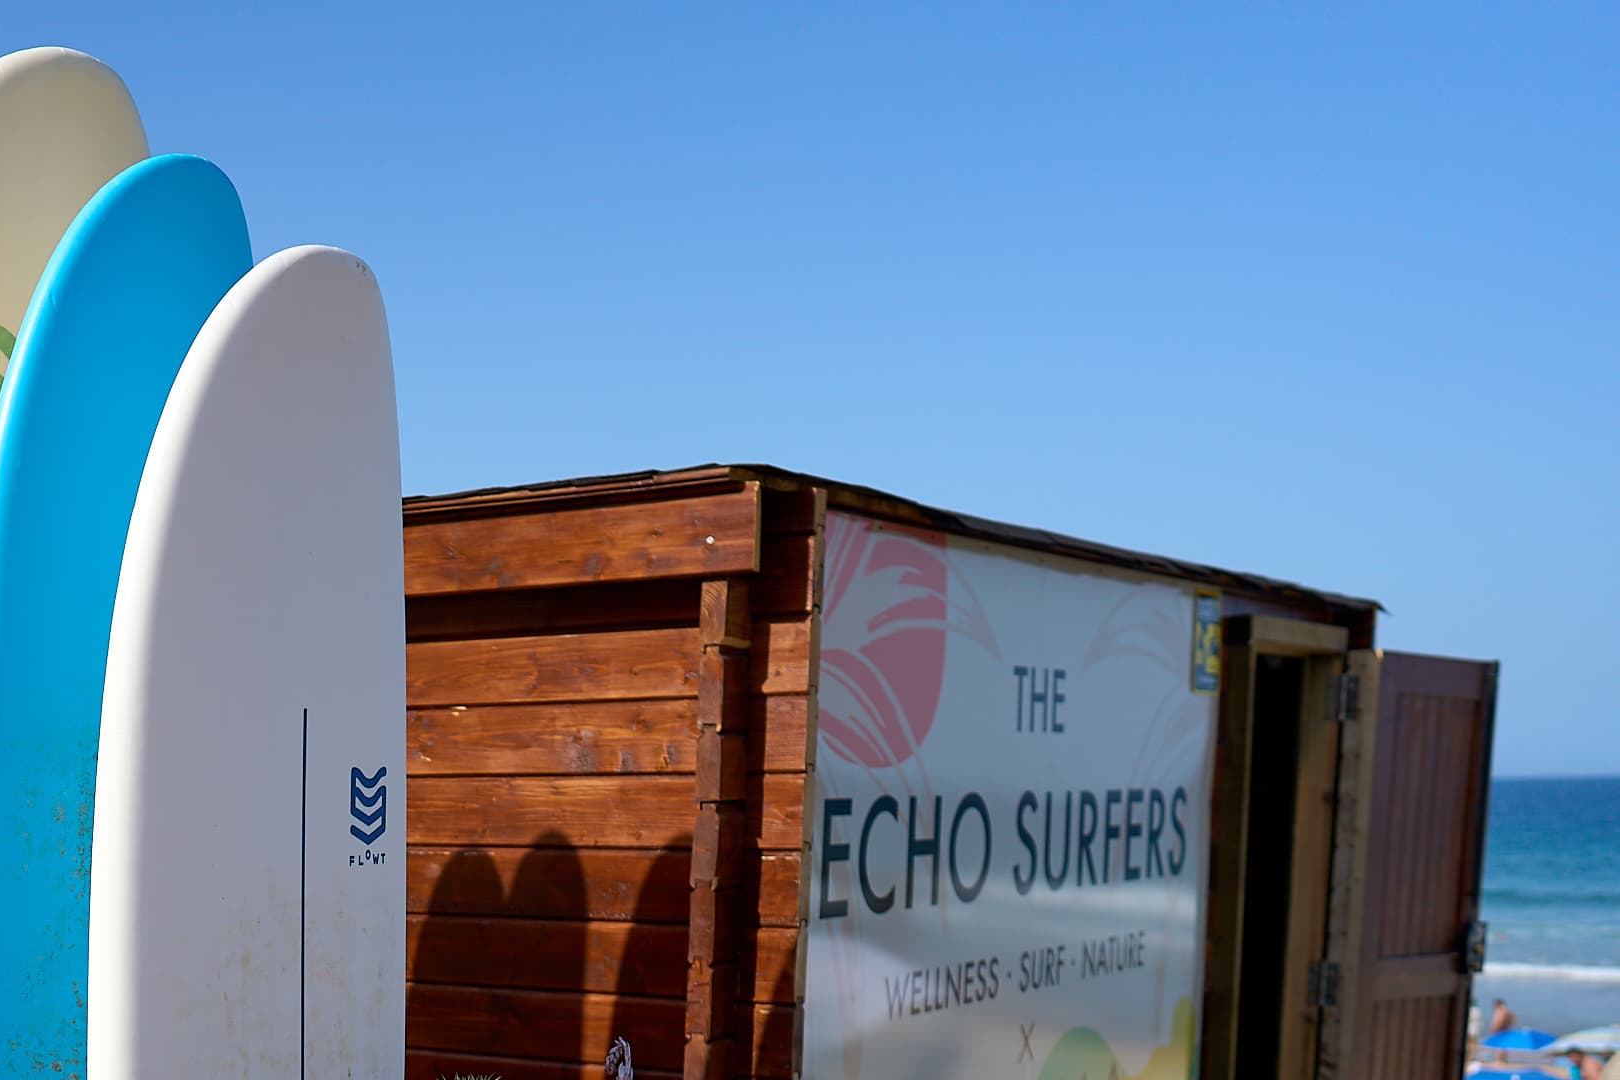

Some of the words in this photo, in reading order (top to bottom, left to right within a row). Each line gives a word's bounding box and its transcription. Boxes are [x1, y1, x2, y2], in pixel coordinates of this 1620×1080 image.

[1013, 667, 1066, 732] THE
[820, 793, 992, 920] ECHO
[1013, 787, 1187, 895] SURFERS
[885, 956, 1000, 1020] WELLNESS
[1019, 944, 1067, 992] SURF
[1082, 931, 1146, 974] NATURE
